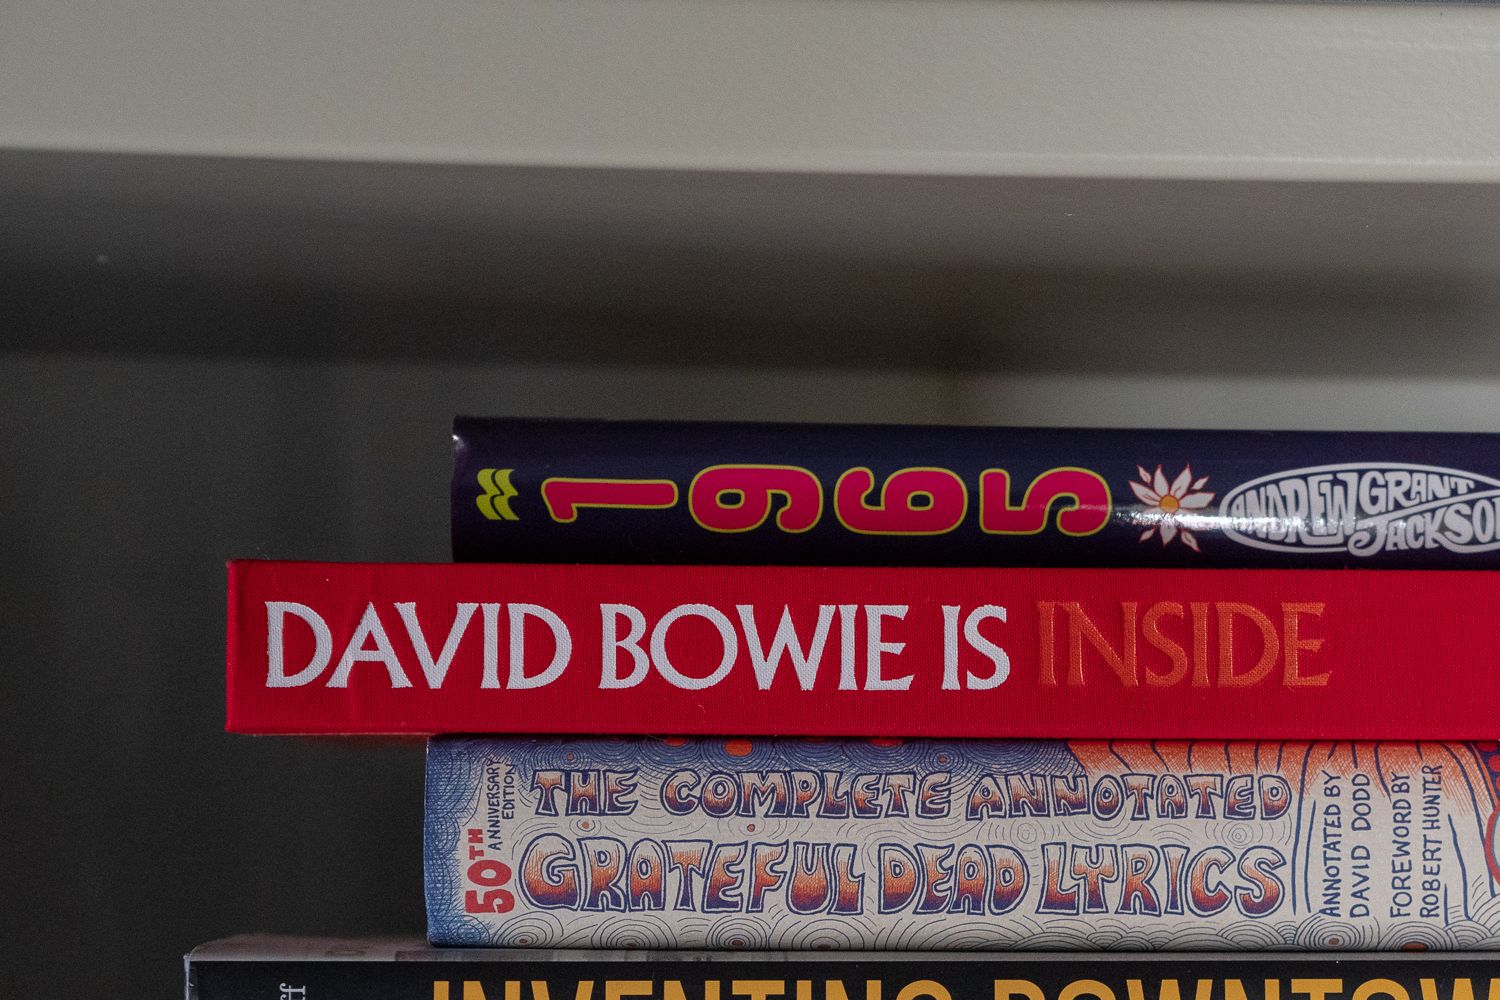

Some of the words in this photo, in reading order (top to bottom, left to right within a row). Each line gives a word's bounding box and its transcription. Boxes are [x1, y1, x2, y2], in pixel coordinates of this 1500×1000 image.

[540, 463, 1112, 537] 1965
[1231, 472, 1358, 546] ANDREW
[1358, 470, 1475, 512] GRANT
[264, 601, 573, 690] DAVID
[598, 603, 914, 691] BOWIE
[941, 604, 1011, 691] IS
[1037, 600, 1332, 689] INSIDE
[486, 755, 503, 851] ANNIVERSARY
[501, 763, 517, 820] EDITION
[529, 769, 640, 818] THE
[660, 769, 953, 820] COMPLETE
[966, 772, 1293, 821] ANNOTATED
[1321, 769, 1342, 798] BY
[1350, 772, 1371, 831] DODD
[1390, 771, 1412, 793] BY
[1420, 763, 1443, 832] HUNTER
[464, 828, 515, 914] 50TH
[518, 832, 867, 916] GRATEFUL
[877, 841, 1030, 917] DEAD
[1035, 841, 1287, 919] LYRICS
[1320, 804, 1342, 918] ANNOTATED
[1350, 842, 1371, 918] DAVID
[1390, 796, 1412, 919] FOREWORD
[1420, 835, 1443, 919] ROBERT
